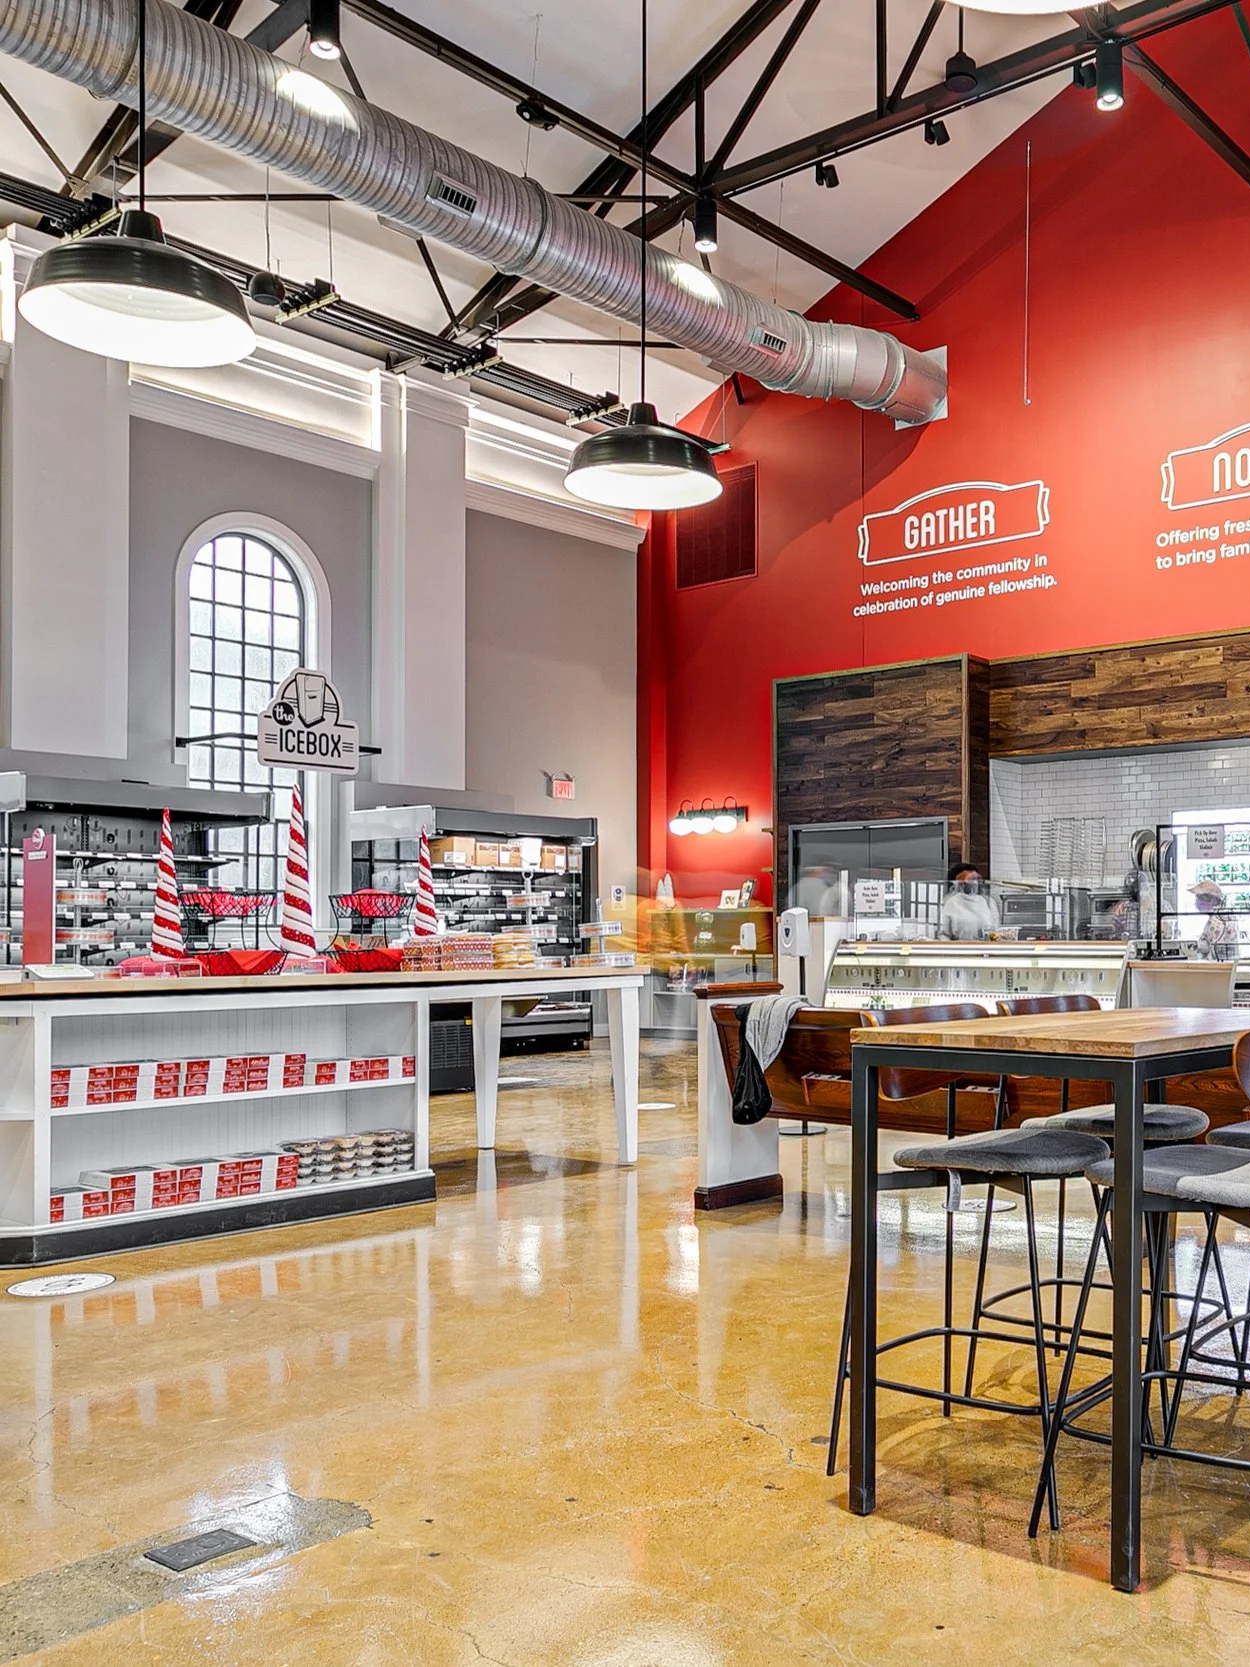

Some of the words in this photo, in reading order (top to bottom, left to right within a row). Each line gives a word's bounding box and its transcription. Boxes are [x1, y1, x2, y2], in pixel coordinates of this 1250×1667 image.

[904, 500, 996, 550] GATHER
[1156, 525, 1220, 548] Offering
[1156, 555, 1172, 570] to
[1176, 547, 1216, 567] bring
[861, 575, 929, 596] Welcoming
[932, 570, 953, 585] the
[957, 556, 1031, 580] community
[1035, 554, 1048, 568] in
[853, 596, 918, 617] celebration
[920, 593, 935, 606] of
[936, 584, 985, 606] genuine
[988, 574, 1057, 595] fellowship.
[273, 704, 295, 722] the
[279, 728, 341, 758] ICEBOX
[555, 782, 572, 798] EXIT
